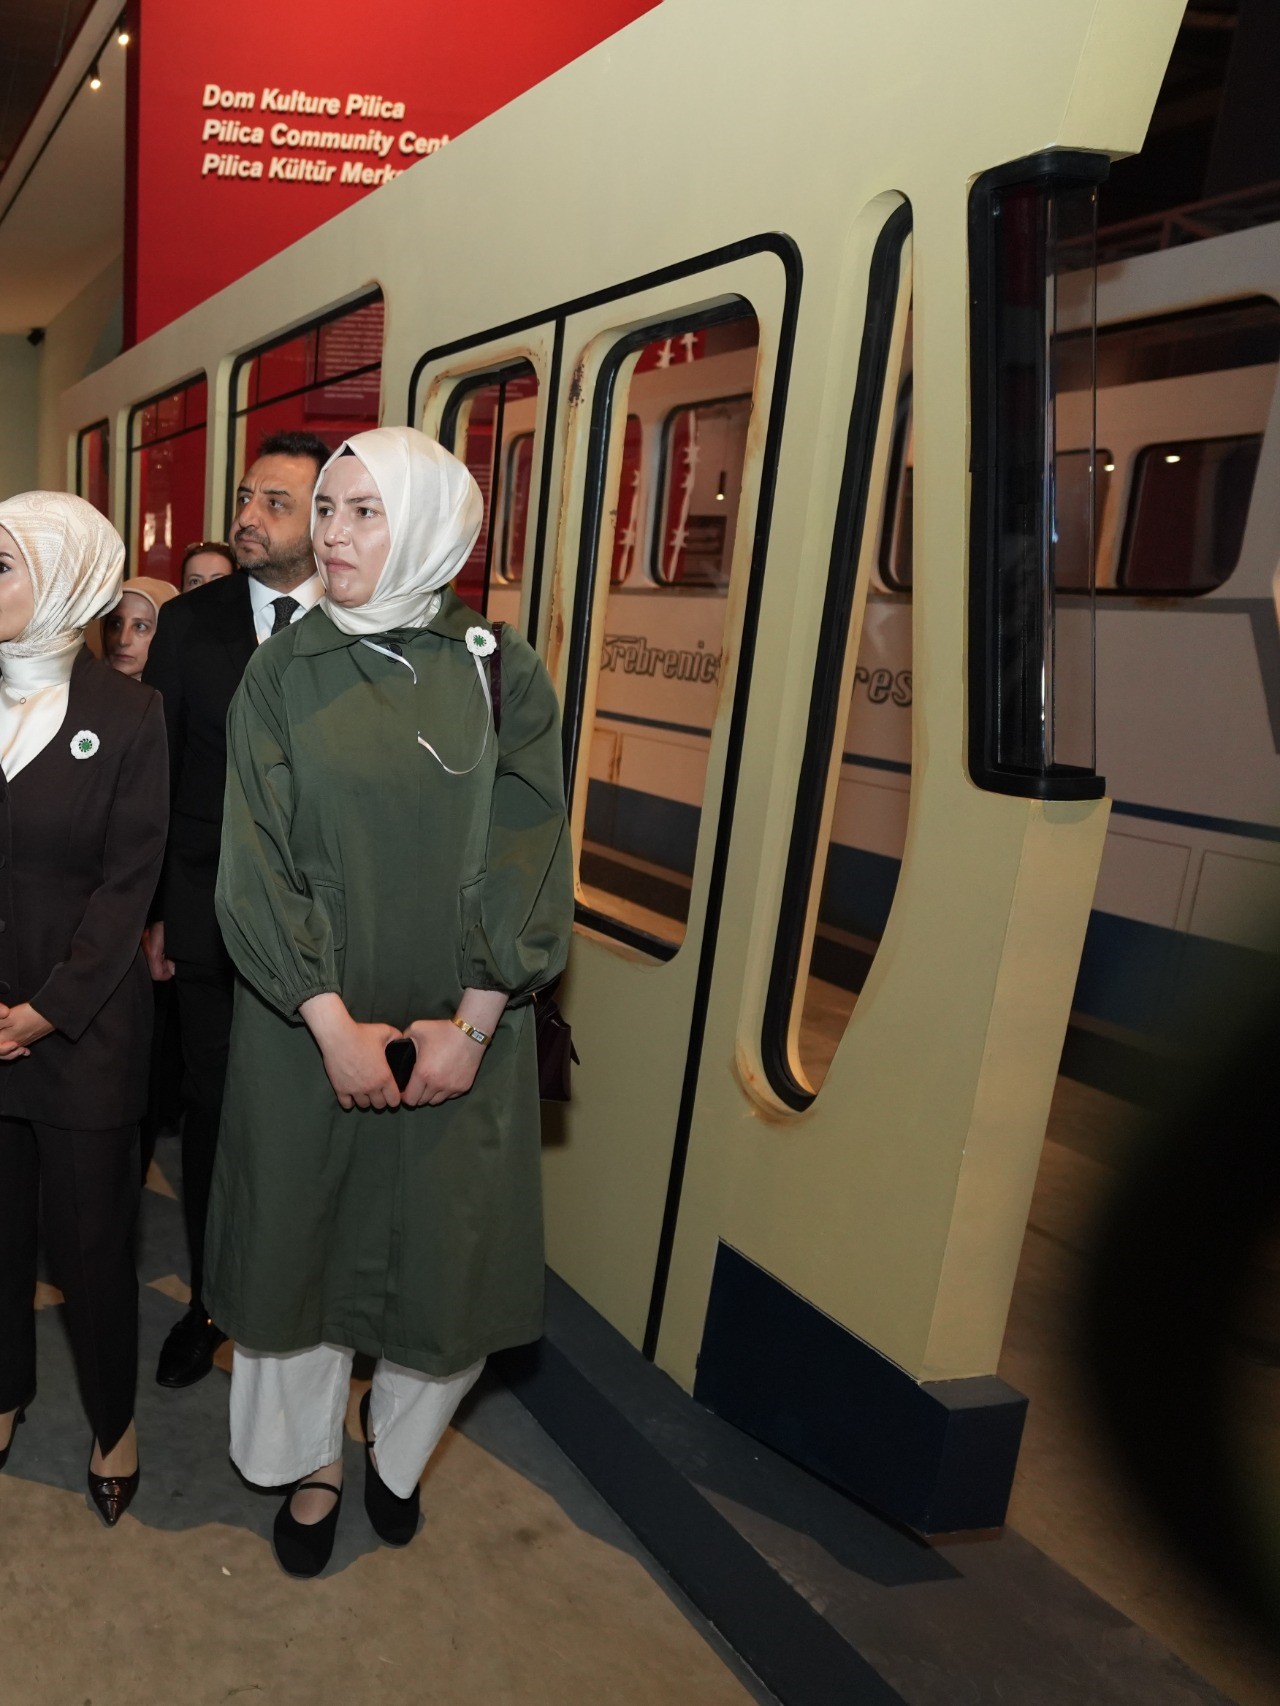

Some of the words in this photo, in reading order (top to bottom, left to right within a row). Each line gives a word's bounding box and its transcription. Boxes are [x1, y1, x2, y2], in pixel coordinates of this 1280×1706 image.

[202, 84, 256, 109] Dom
[260, 87, 342, 116] Kulture
[345, 93, 406, 120] Pilica
[202, 118, 265, 145] Pilica
[270, 122, 395, 157] Community
[202, 152, 264, 178] Pilica
[268, 156, 337, 183] Kültür
[340, 161, 404, 186] Merk
[600, 633, 722, 688] Srebrenic
